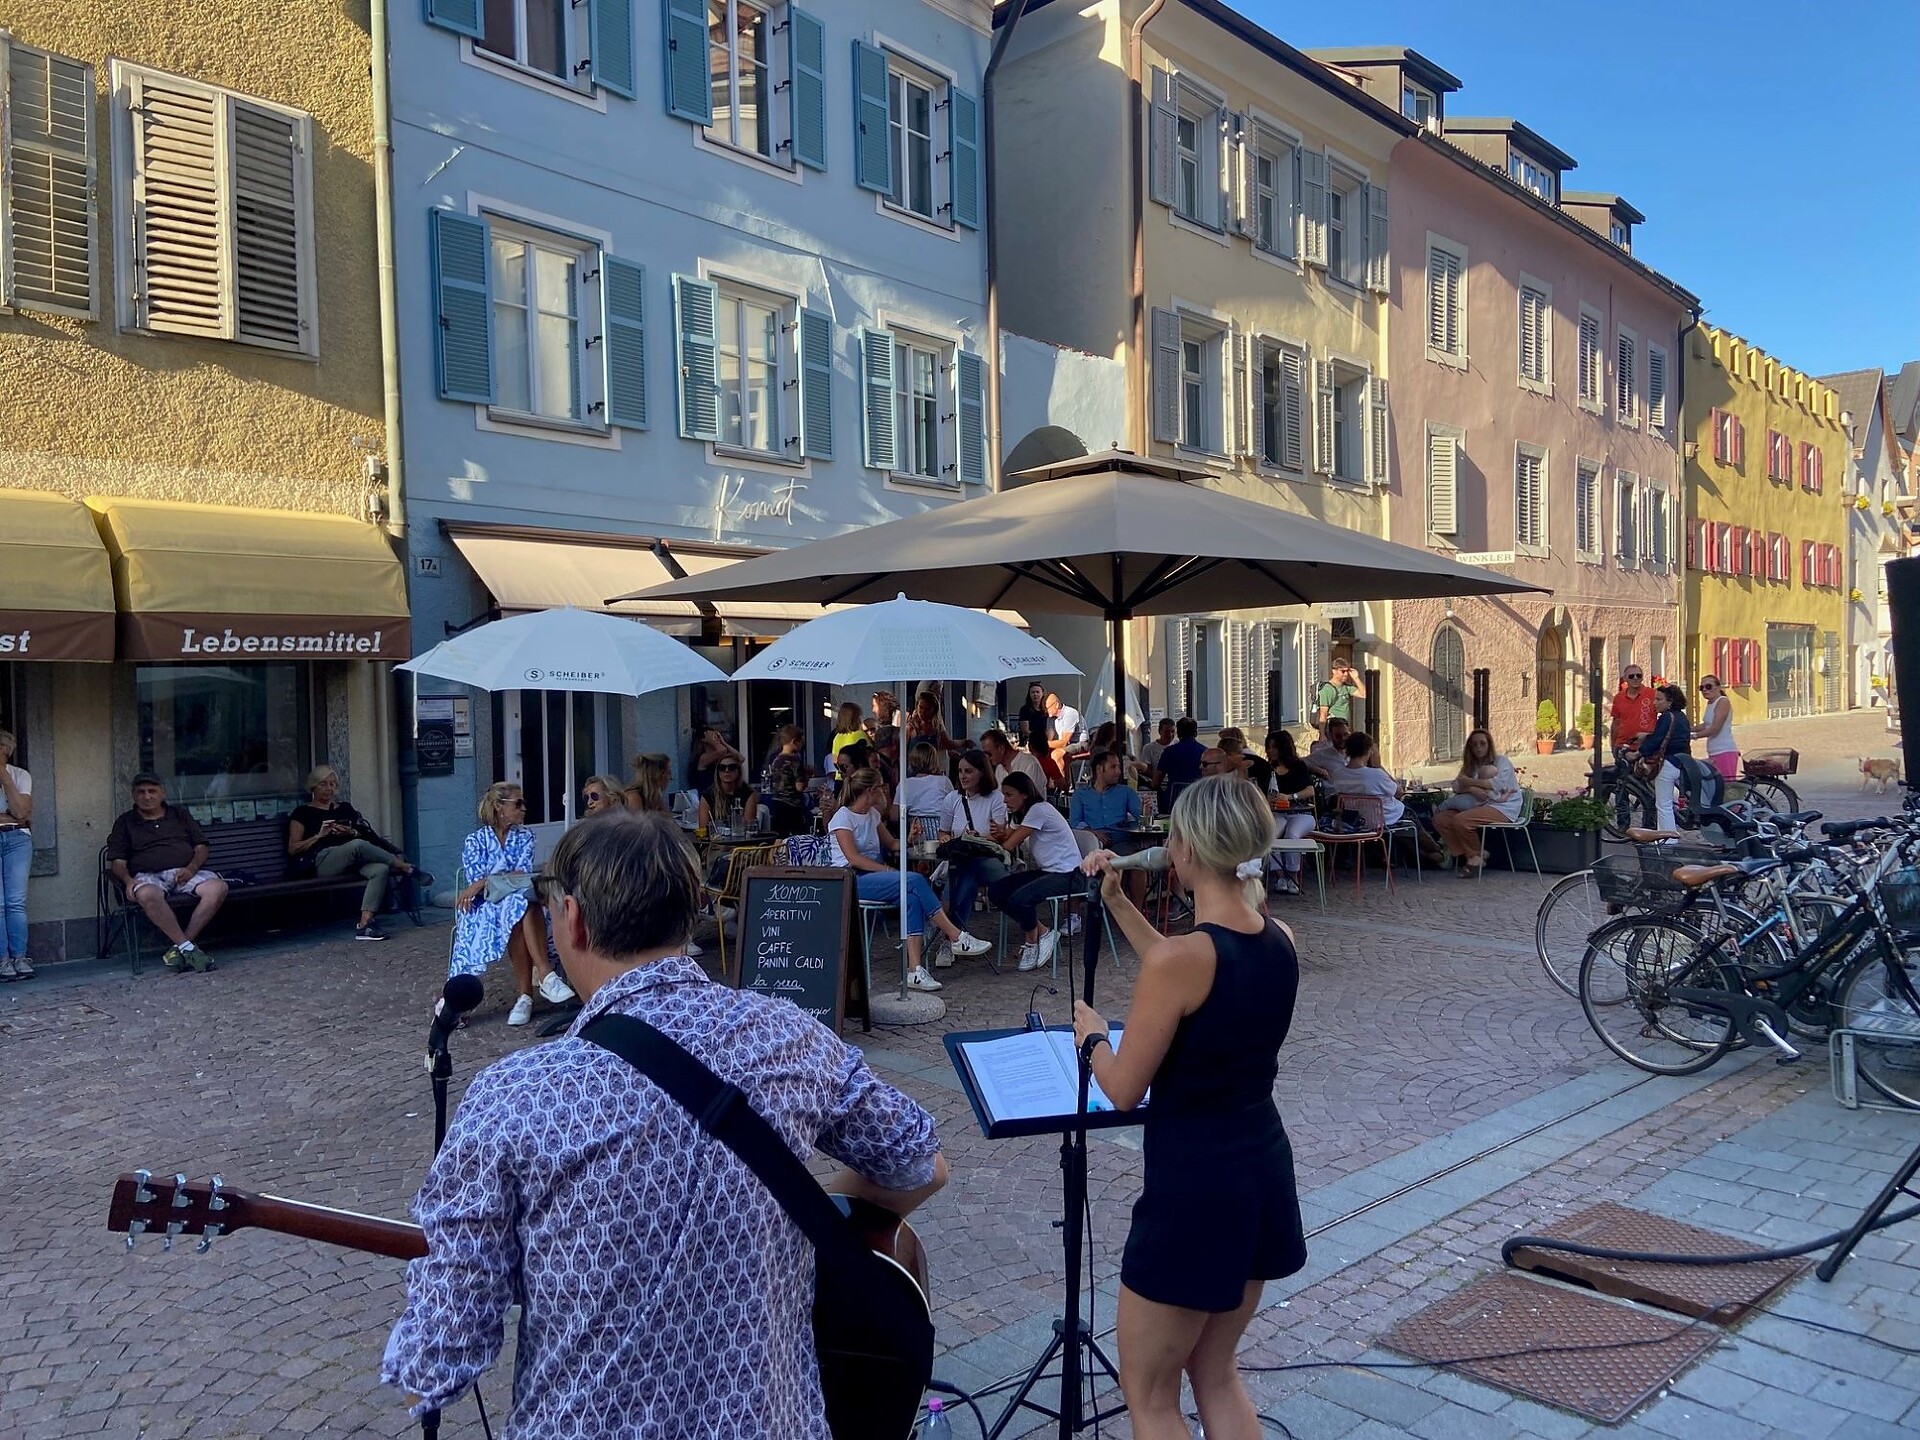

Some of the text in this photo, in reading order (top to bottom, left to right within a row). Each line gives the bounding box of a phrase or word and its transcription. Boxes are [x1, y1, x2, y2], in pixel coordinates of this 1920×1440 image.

[1458, 554, 1512, 563] WINKLER
[181, 628, 383, 654] Lebensmittel
[767, 884, 823, 902] KOMOT
[760, 908, 812, 921] APERITIVI
[761, 926, 781, 938] VINI
[757, 956, 825, 970] PANINI CALDI
